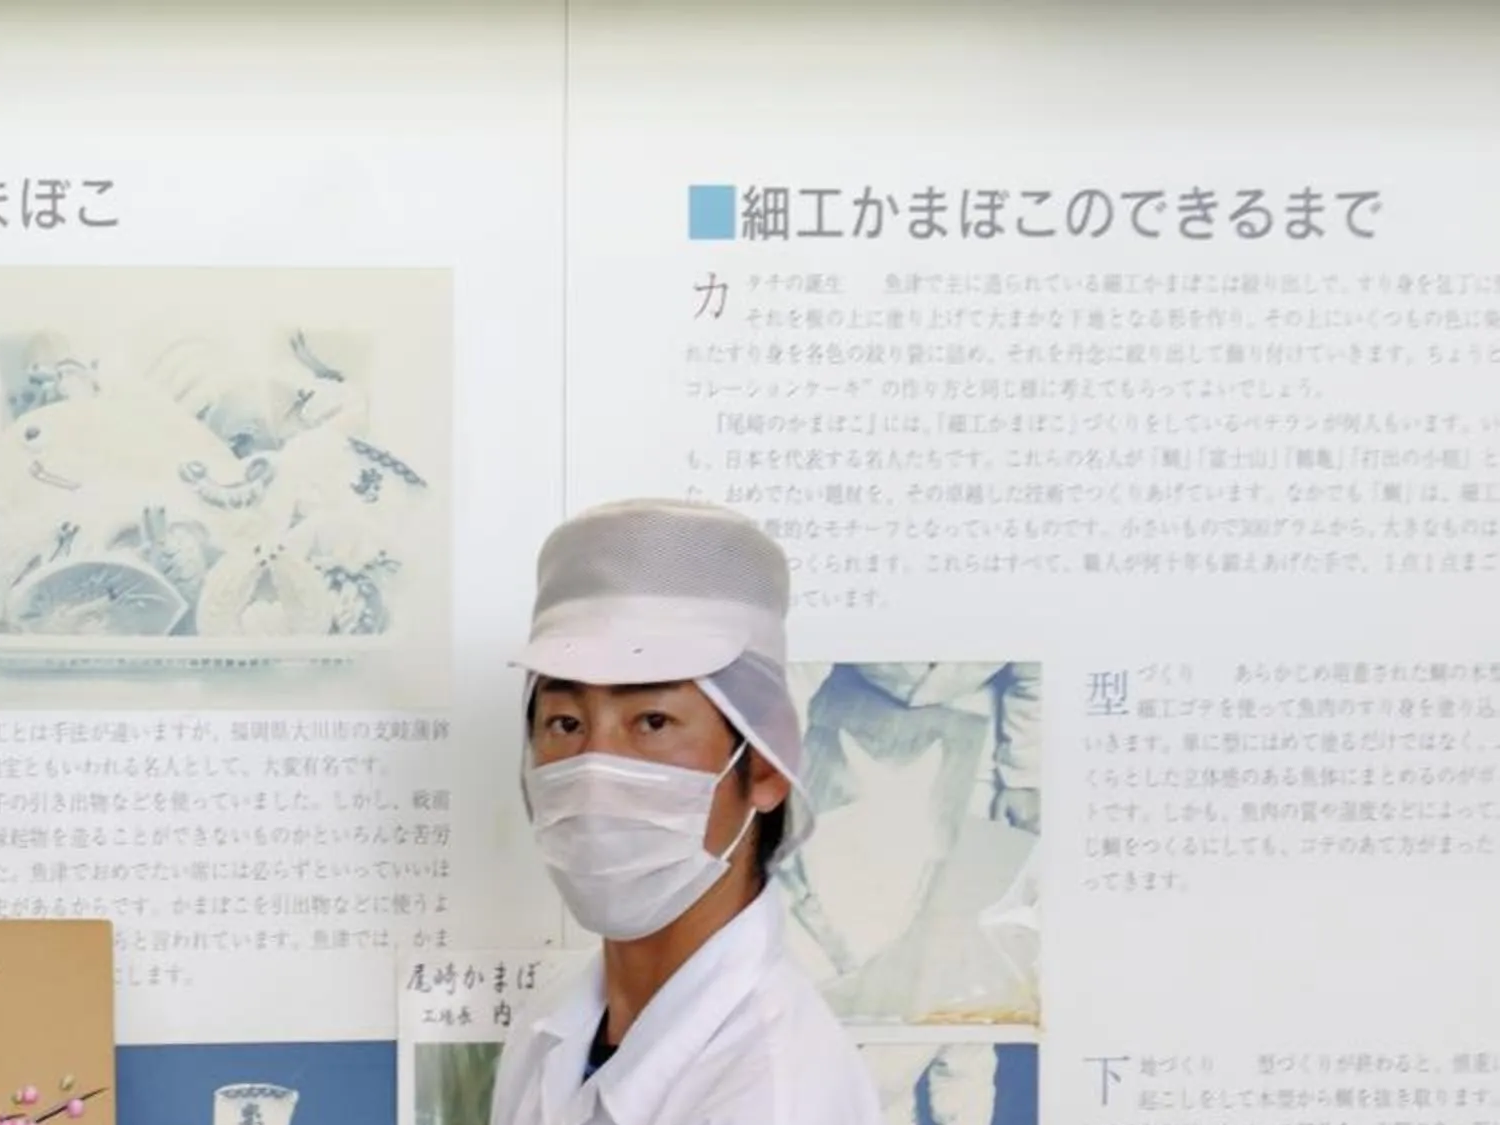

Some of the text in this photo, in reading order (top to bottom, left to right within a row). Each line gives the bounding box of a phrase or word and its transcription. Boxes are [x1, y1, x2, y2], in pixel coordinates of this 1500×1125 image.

[741, 185, 1382, 240] 細工かまぼこのできるまで
